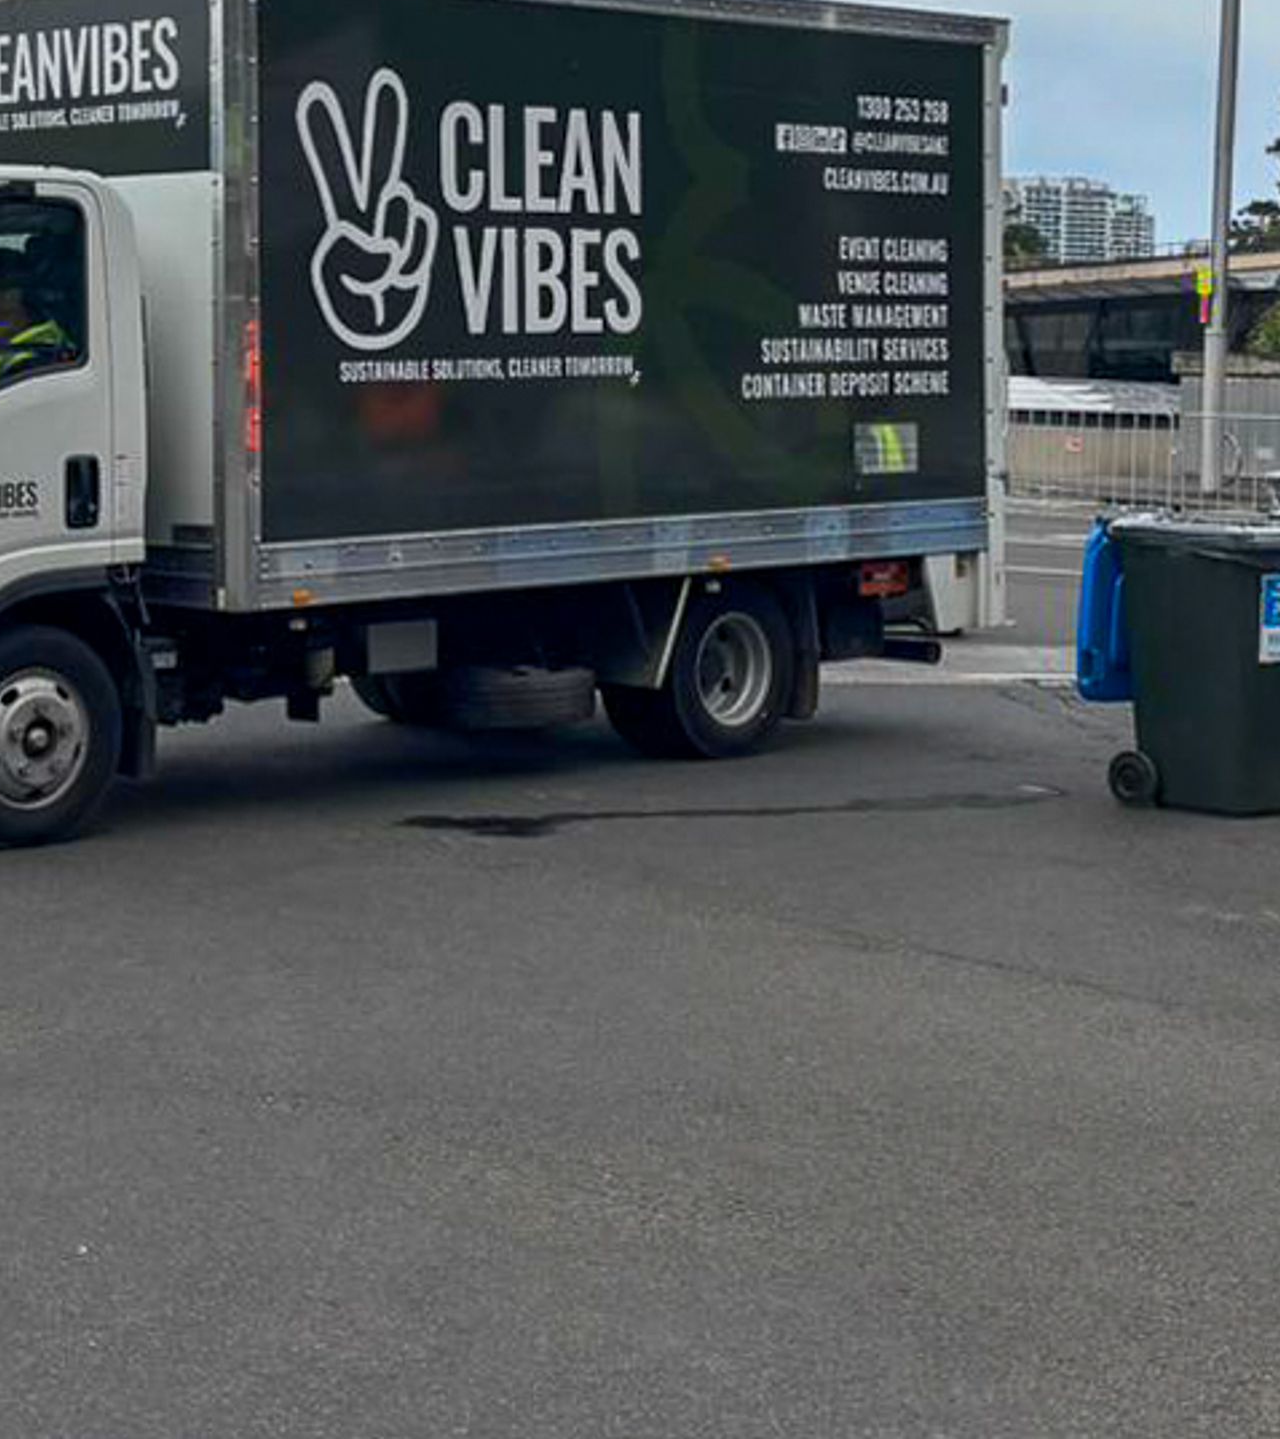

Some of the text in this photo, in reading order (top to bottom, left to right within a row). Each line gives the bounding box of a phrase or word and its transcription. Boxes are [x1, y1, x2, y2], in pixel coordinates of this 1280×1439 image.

[857, 95, 890, 120] 1300
[440, 101, 641, 215] CLEAN
[839, 235, 948, 262] EVENT CLEANING
[453, 226, 642, 335] VIBES
[838, 270, 948, 295] VENUE CLEANING
[798, 303, 948, 328] WASTE MANAGEMENT
[761, 337, 949, 364] SUSTAINABILITY SERVICES
[340, 360, 429, 382] SUSTAINABLE
[508, 357, 562, 377] CLEANER
[741, 369, 950, 399] CONTAINER DEPOSIT SCHEME
